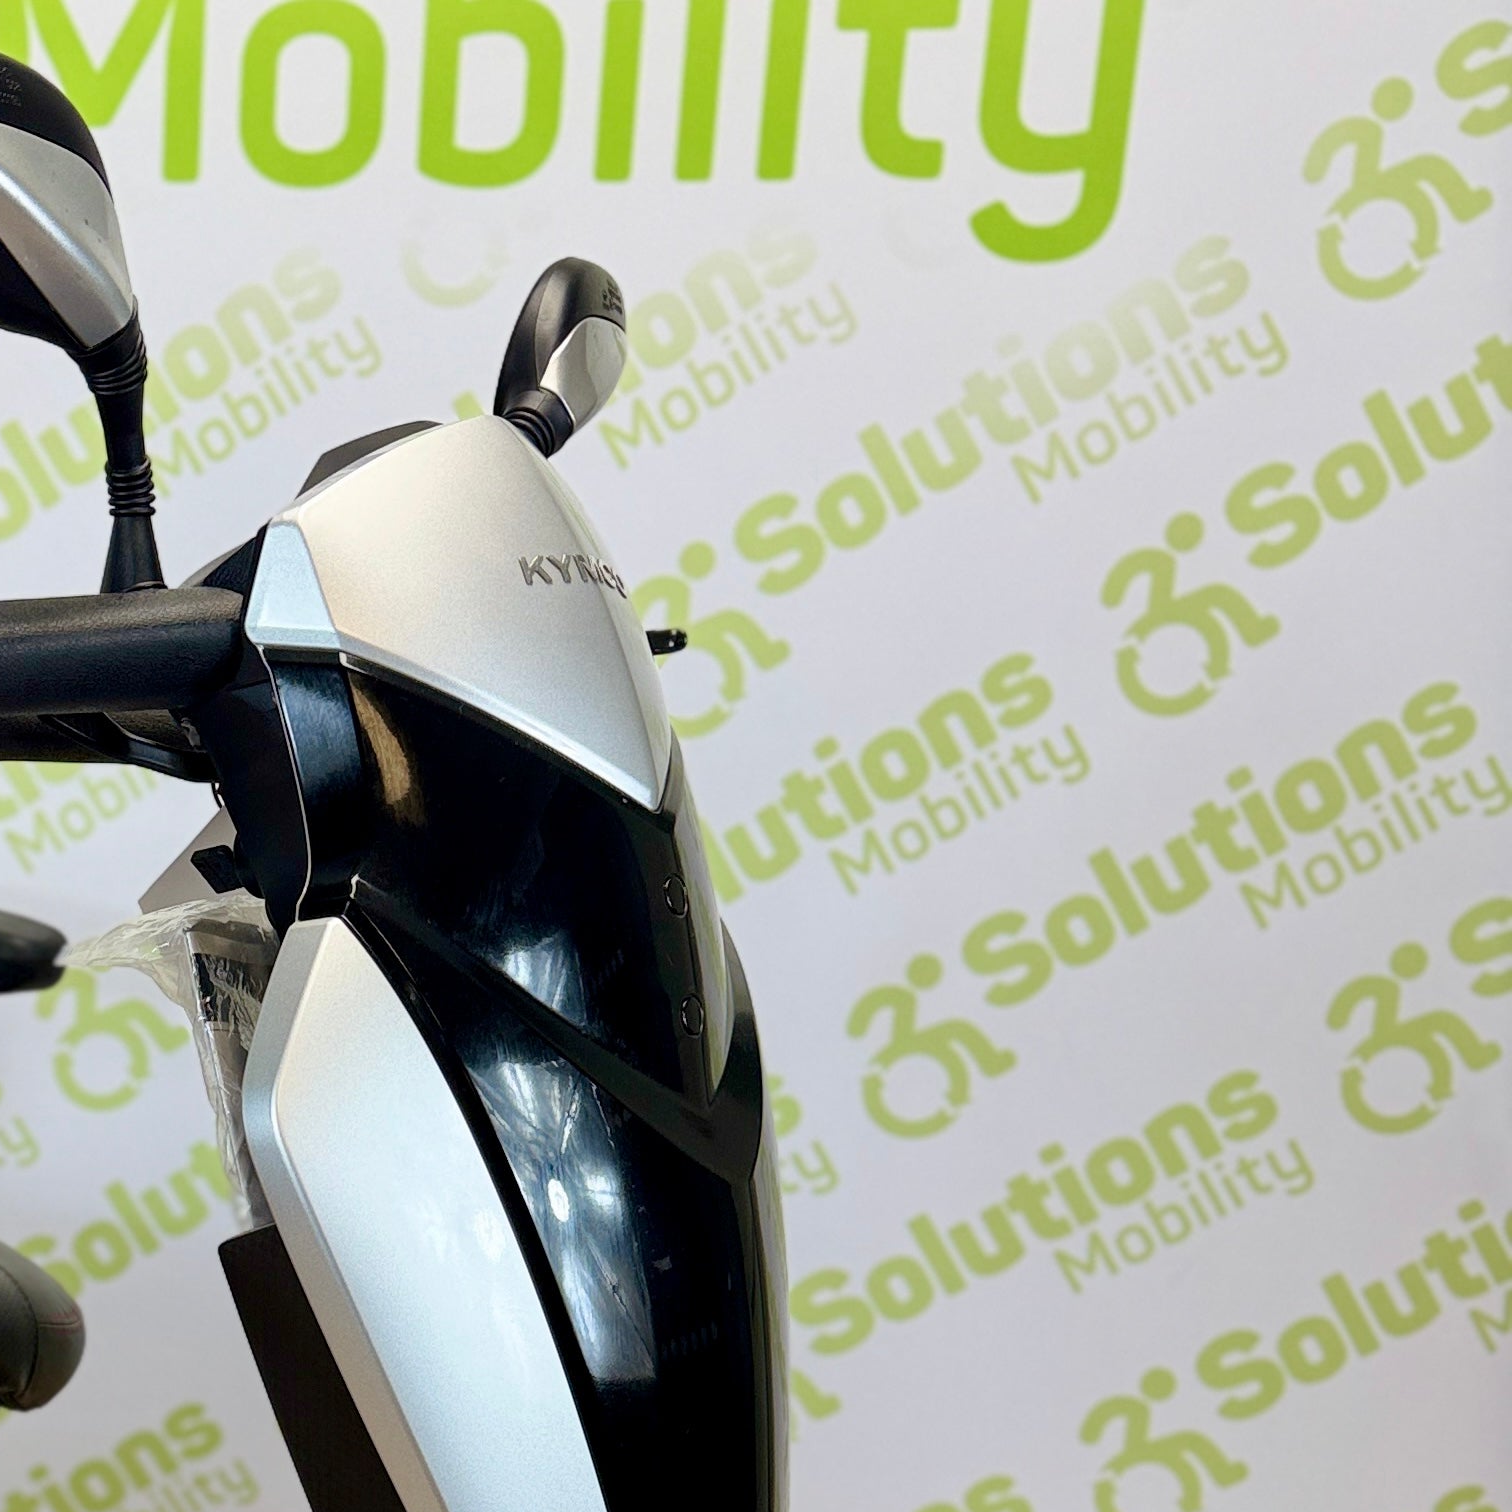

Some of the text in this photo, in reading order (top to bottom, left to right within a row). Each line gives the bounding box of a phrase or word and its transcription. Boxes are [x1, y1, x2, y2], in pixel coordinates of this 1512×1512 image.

[145, 318, 382, 498] Mobility
[595, 282, 860, 471] Mobility
[733, 237, 1250, 596] Solutions
[1011, 311, 1291, 505] Mobility
[696, 653, 1053, 903] lutions
[828, 724, 1091, 895] Mobility
[962, 682, 1477, 1007] Solutions
[1239, 755, 1512, 928] Mobility
[788, 1070, 1278, 1355] Solutions
[1054, 1139, 1316, 1293] Mobility
